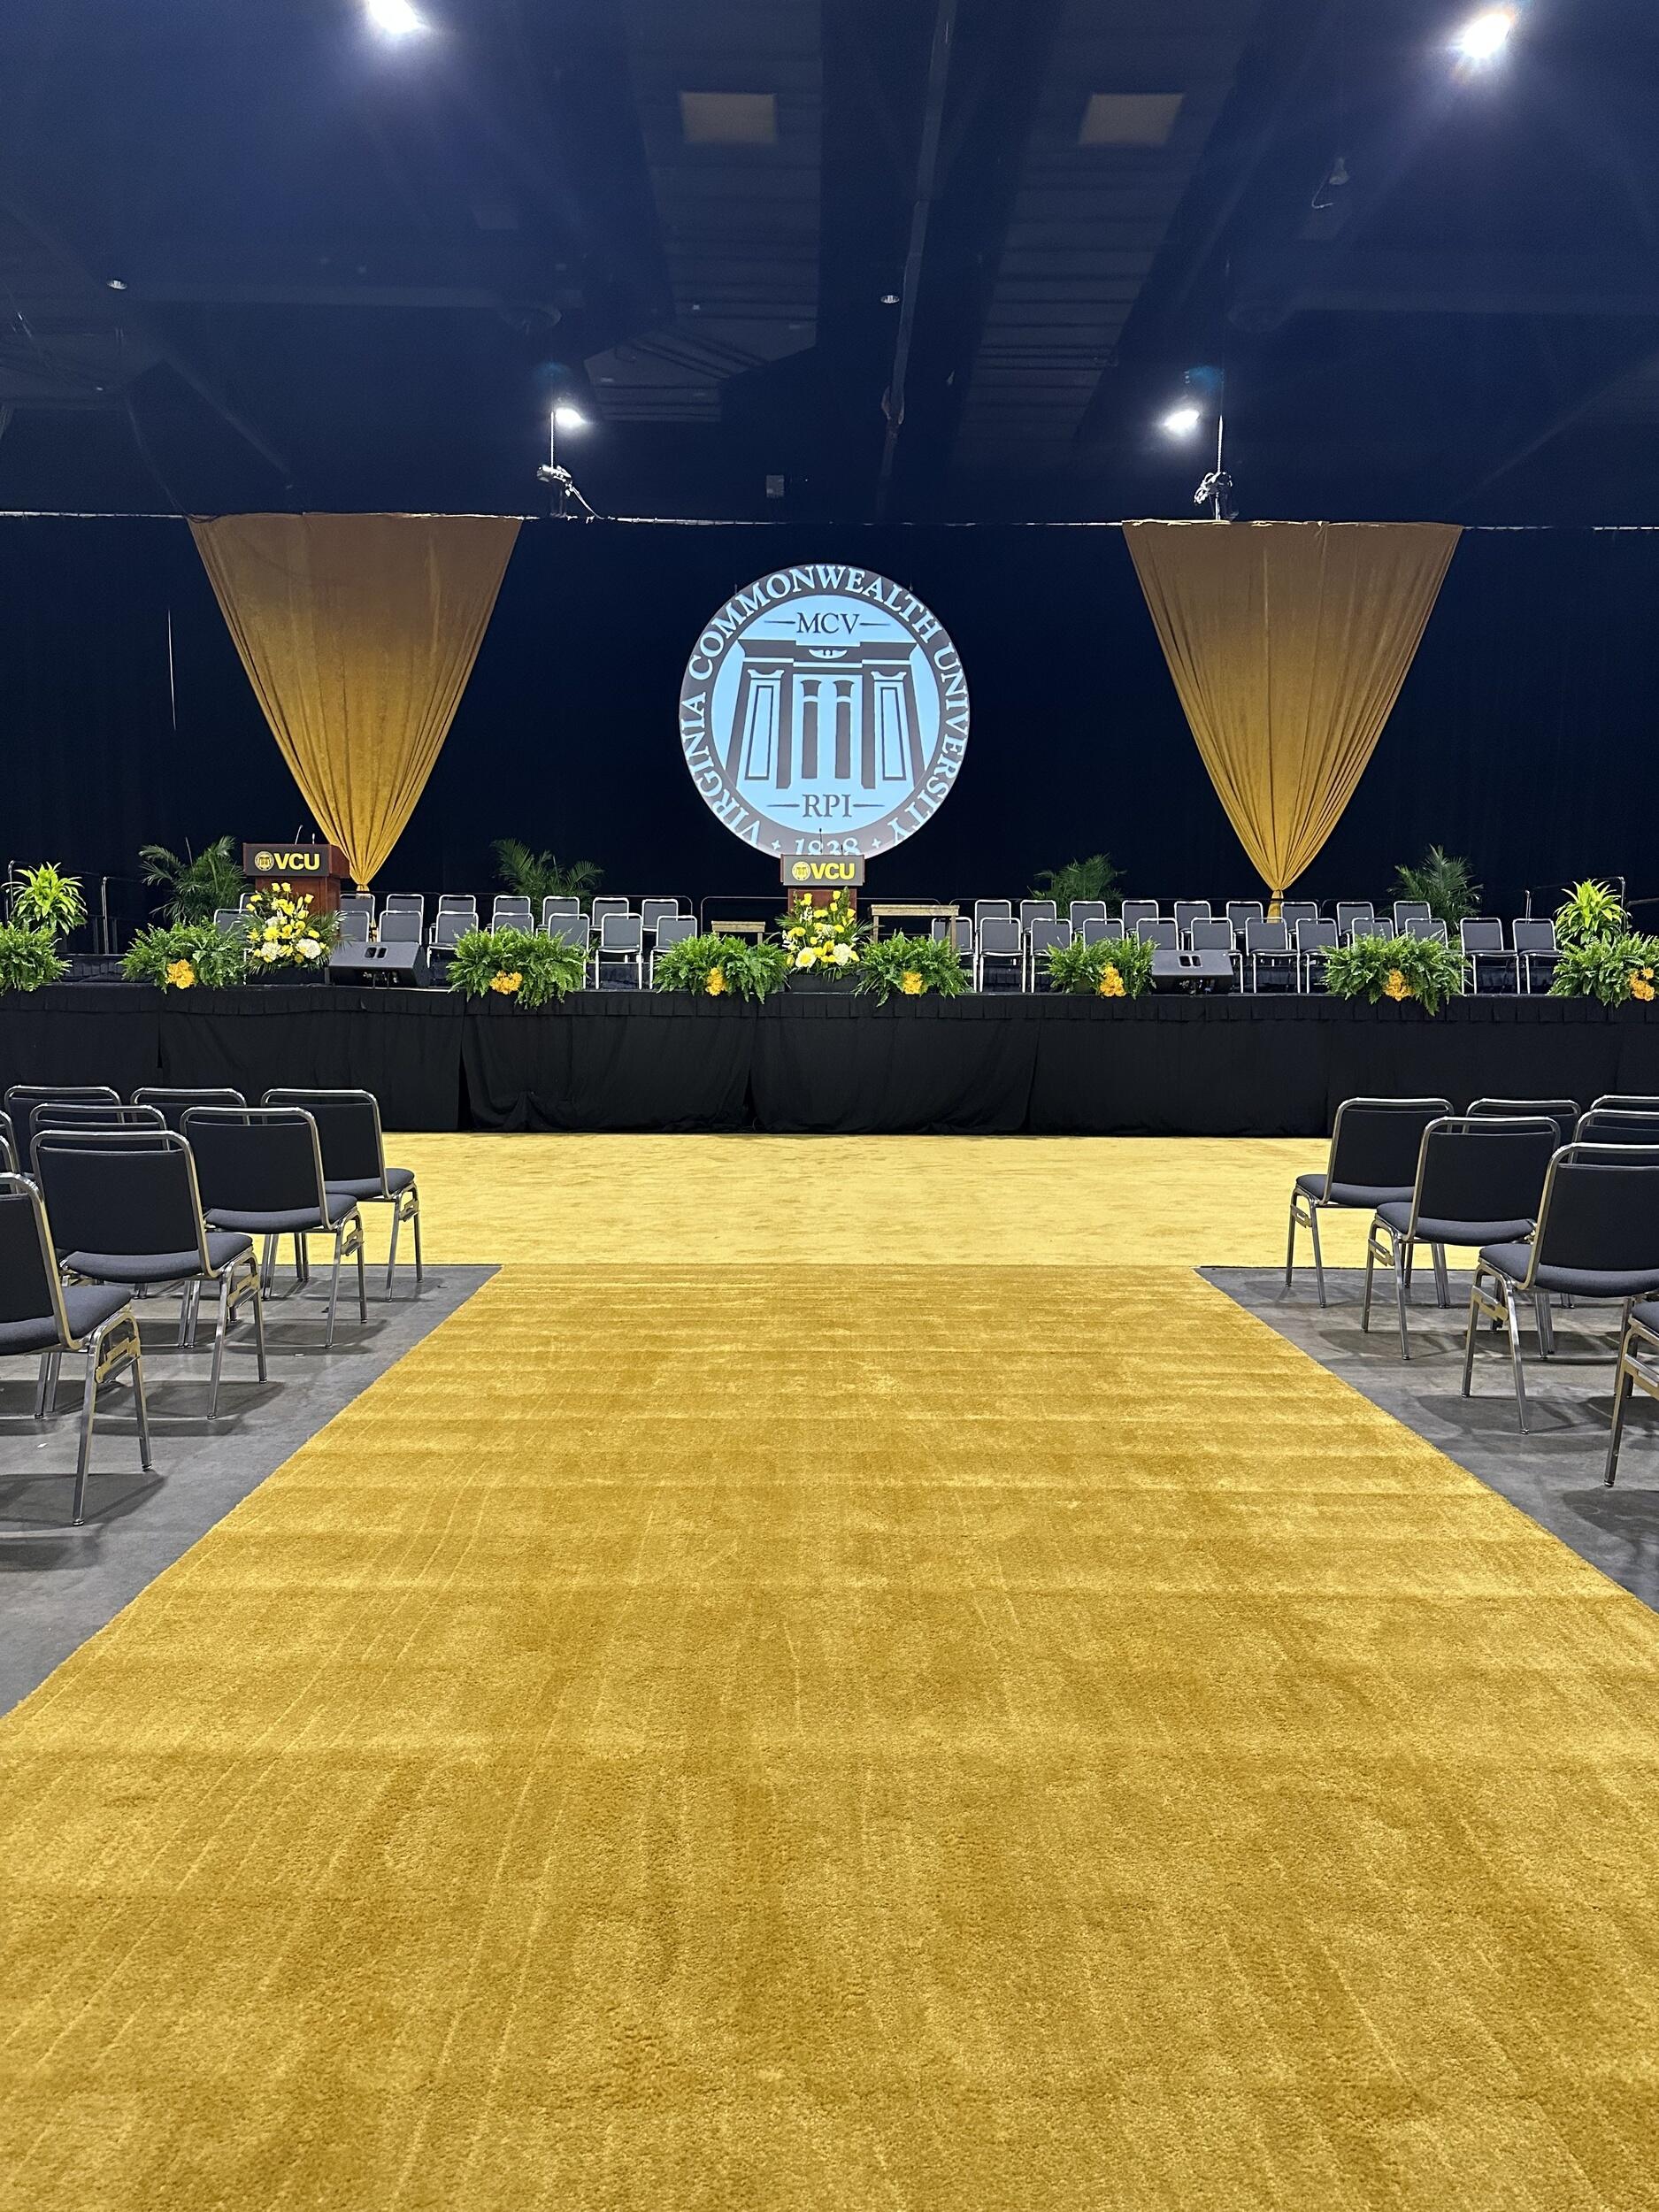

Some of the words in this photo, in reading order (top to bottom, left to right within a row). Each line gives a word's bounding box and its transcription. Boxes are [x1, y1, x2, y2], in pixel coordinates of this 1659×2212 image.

[688, 565, 942, 680] COMMONWEALTH
[796, 612, 860, 634] MCV
[887, 641, 970, 843] UNIVERSITY
[680, 691, 762, 849] VIRGINIA
[802, 794, 853, 818] RPI
[274, 853, 320, 870] VCU
[810, 863, 855, 879] VCU
